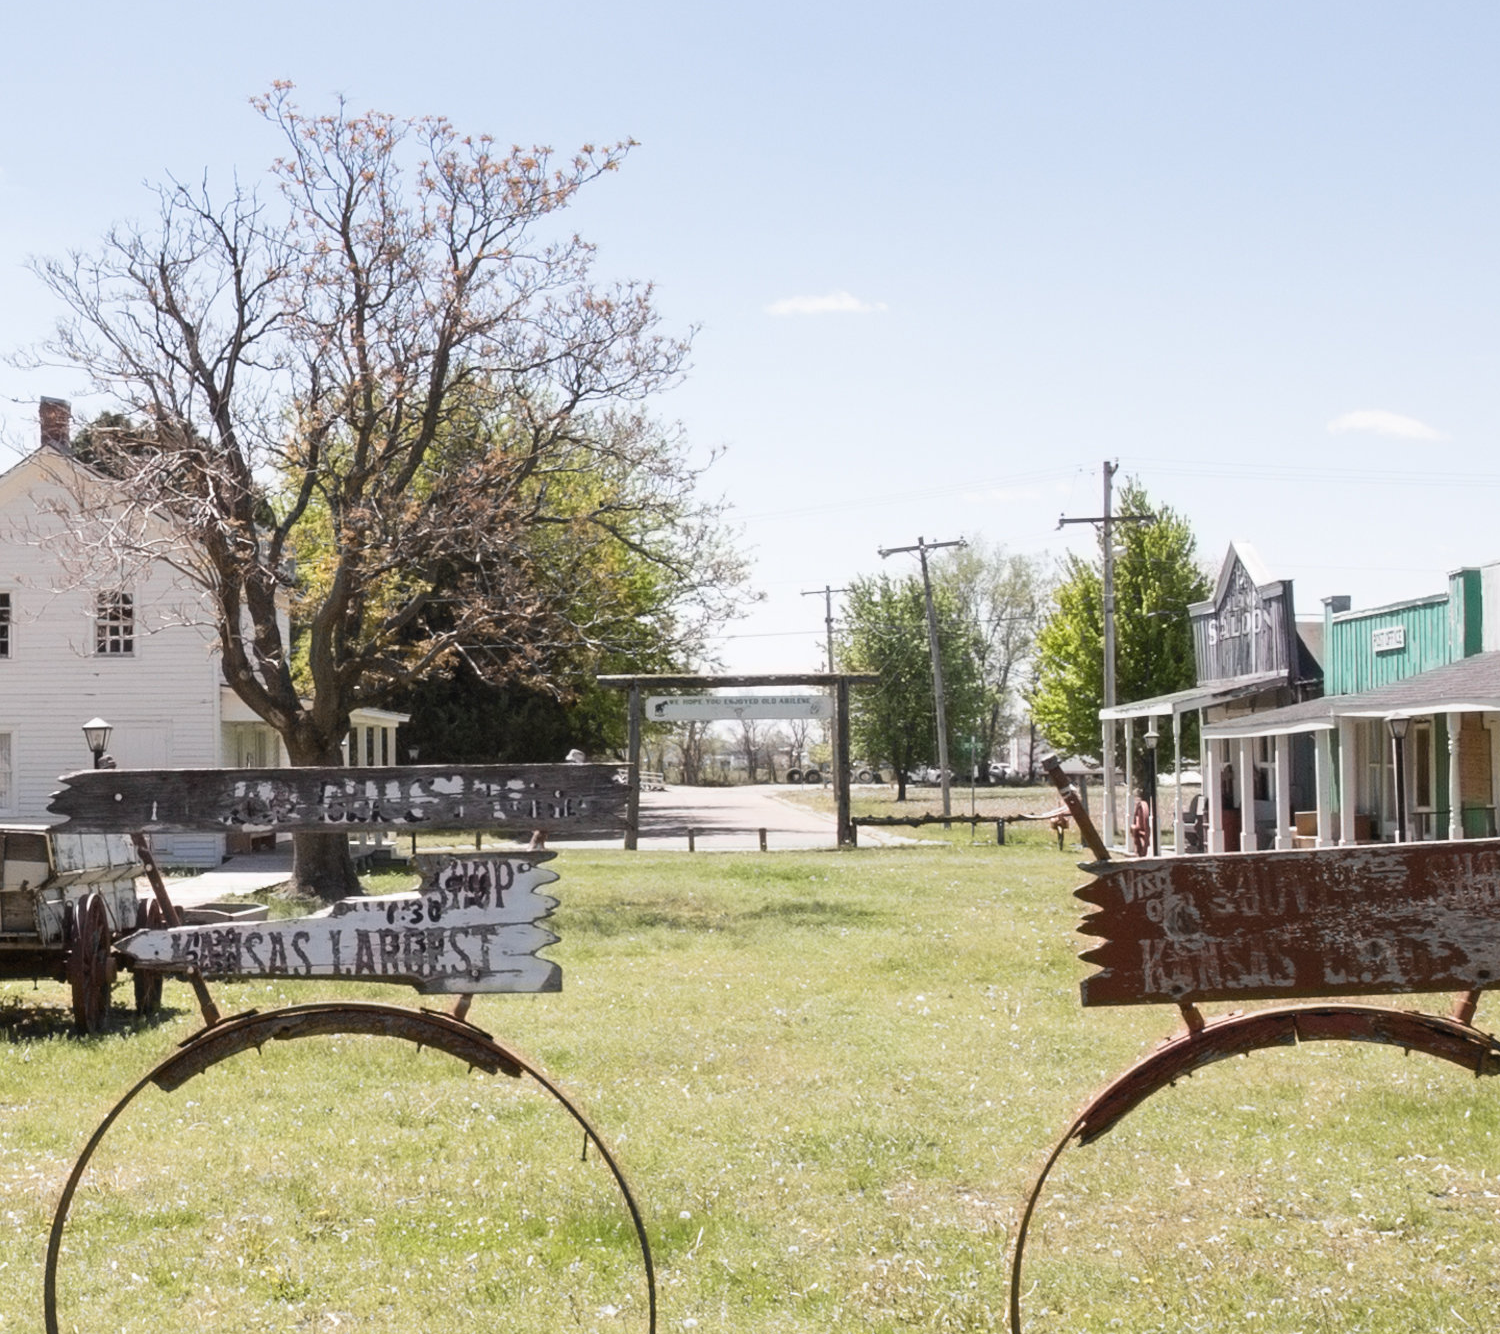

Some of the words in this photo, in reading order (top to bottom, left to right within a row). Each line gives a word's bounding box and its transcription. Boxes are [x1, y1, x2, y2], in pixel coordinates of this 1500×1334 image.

[1208, 606, 1276, 646] SALOON
[1373, 631, 1385, 647] POST
[329, 925, 499, 977] LARGEST
